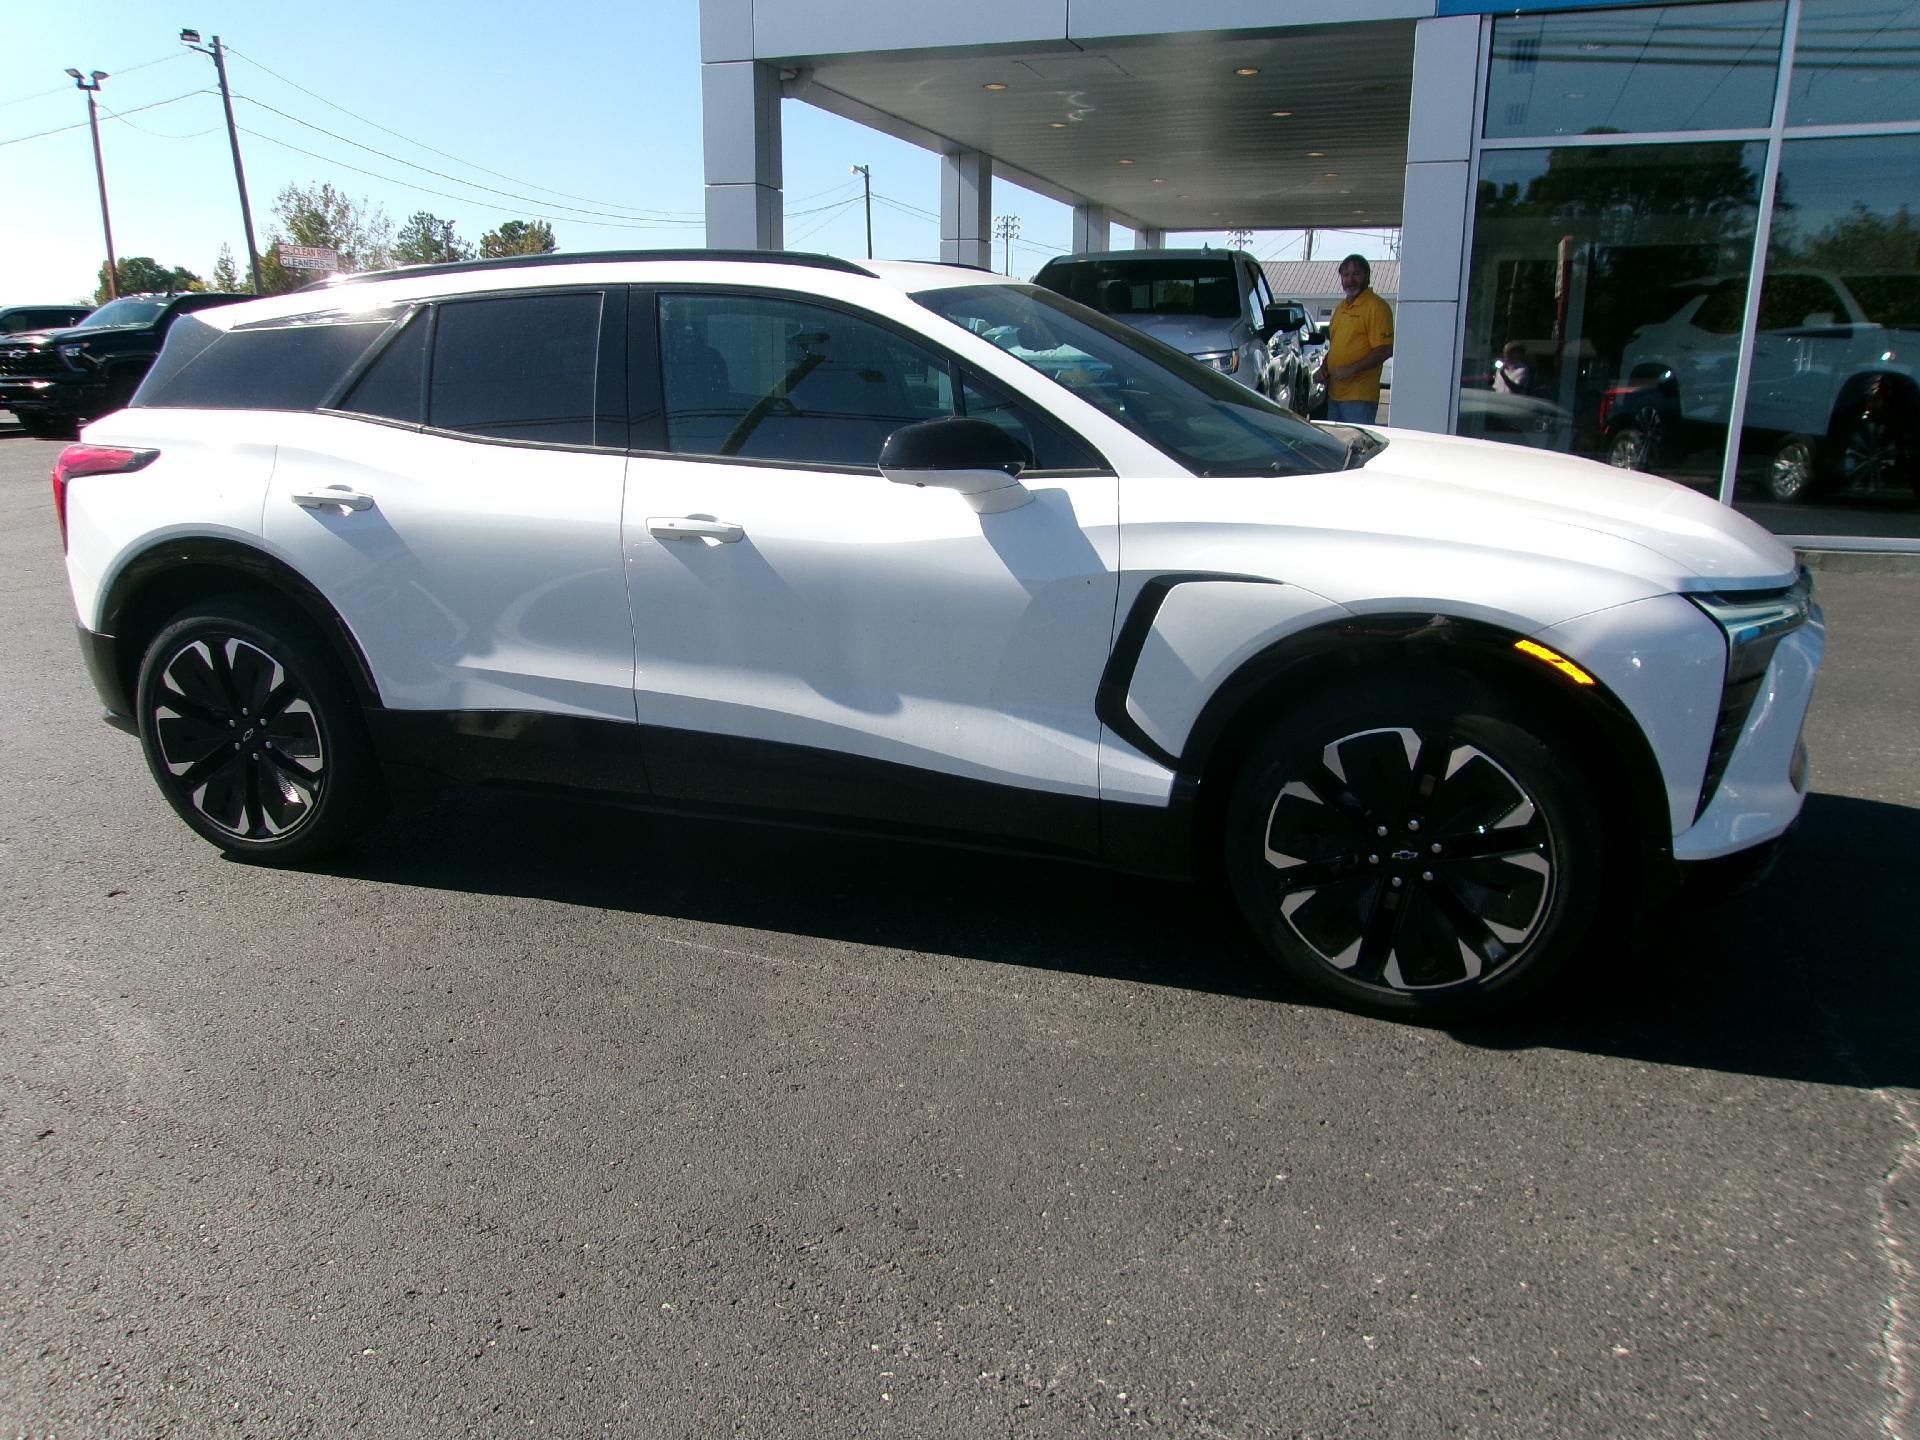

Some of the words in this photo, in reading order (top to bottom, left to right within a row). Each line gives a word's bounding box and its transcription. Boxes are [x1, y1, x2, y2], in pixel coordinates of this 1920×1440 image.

[293, 247, 315, 257] CLEAN
[316, 248, 336, 258] RIGHT
[282, 257, 325, 268] CLEANERS
